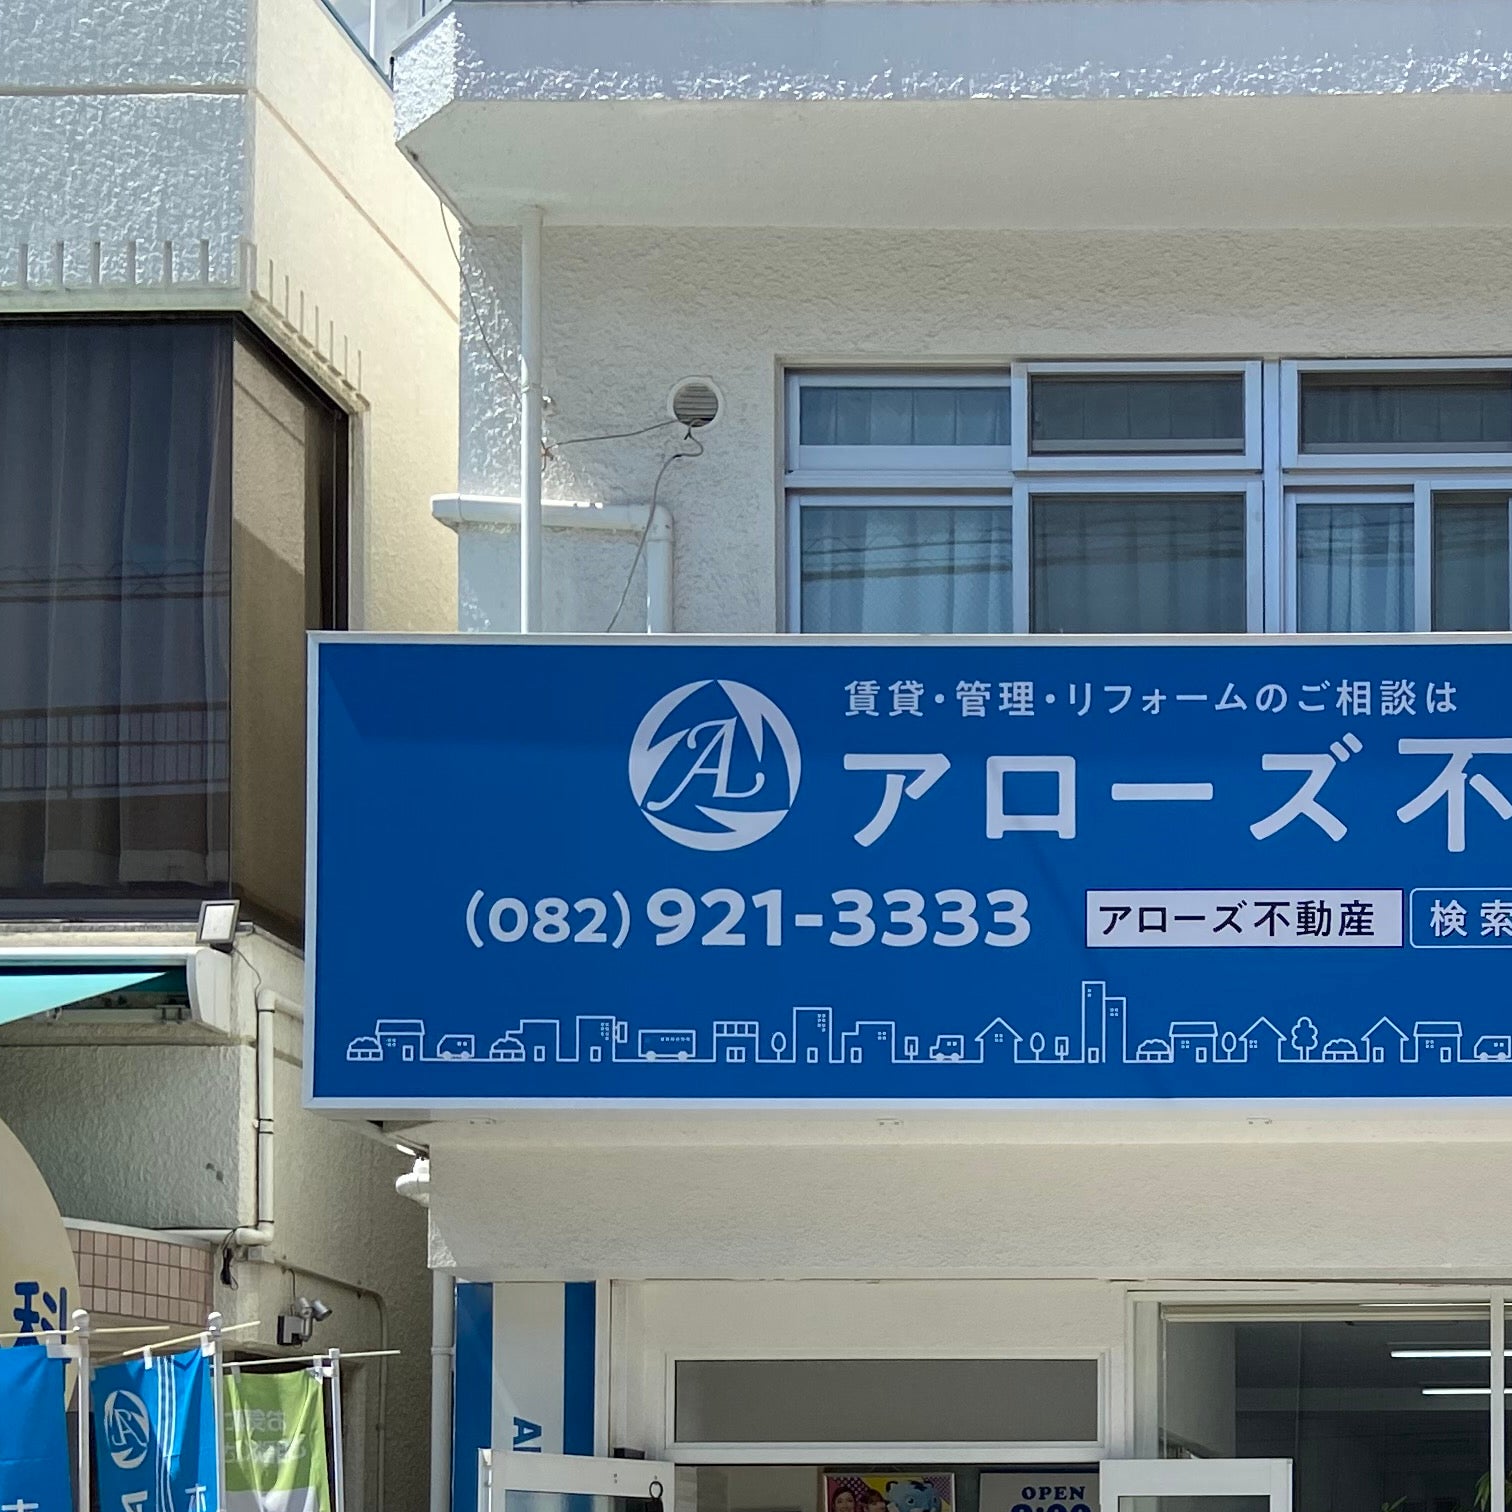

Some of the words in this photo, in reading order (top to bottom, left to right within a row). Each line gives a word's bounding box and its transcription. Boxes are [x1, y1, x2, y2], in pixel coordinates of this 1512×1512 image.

[844, 679, 1458, 718] 賃貸・管理・リフォームのご相談は
[1098, 898, 1376, 937] アローズ不動産
[1021, 1486, 1086, 1500] OPEN
